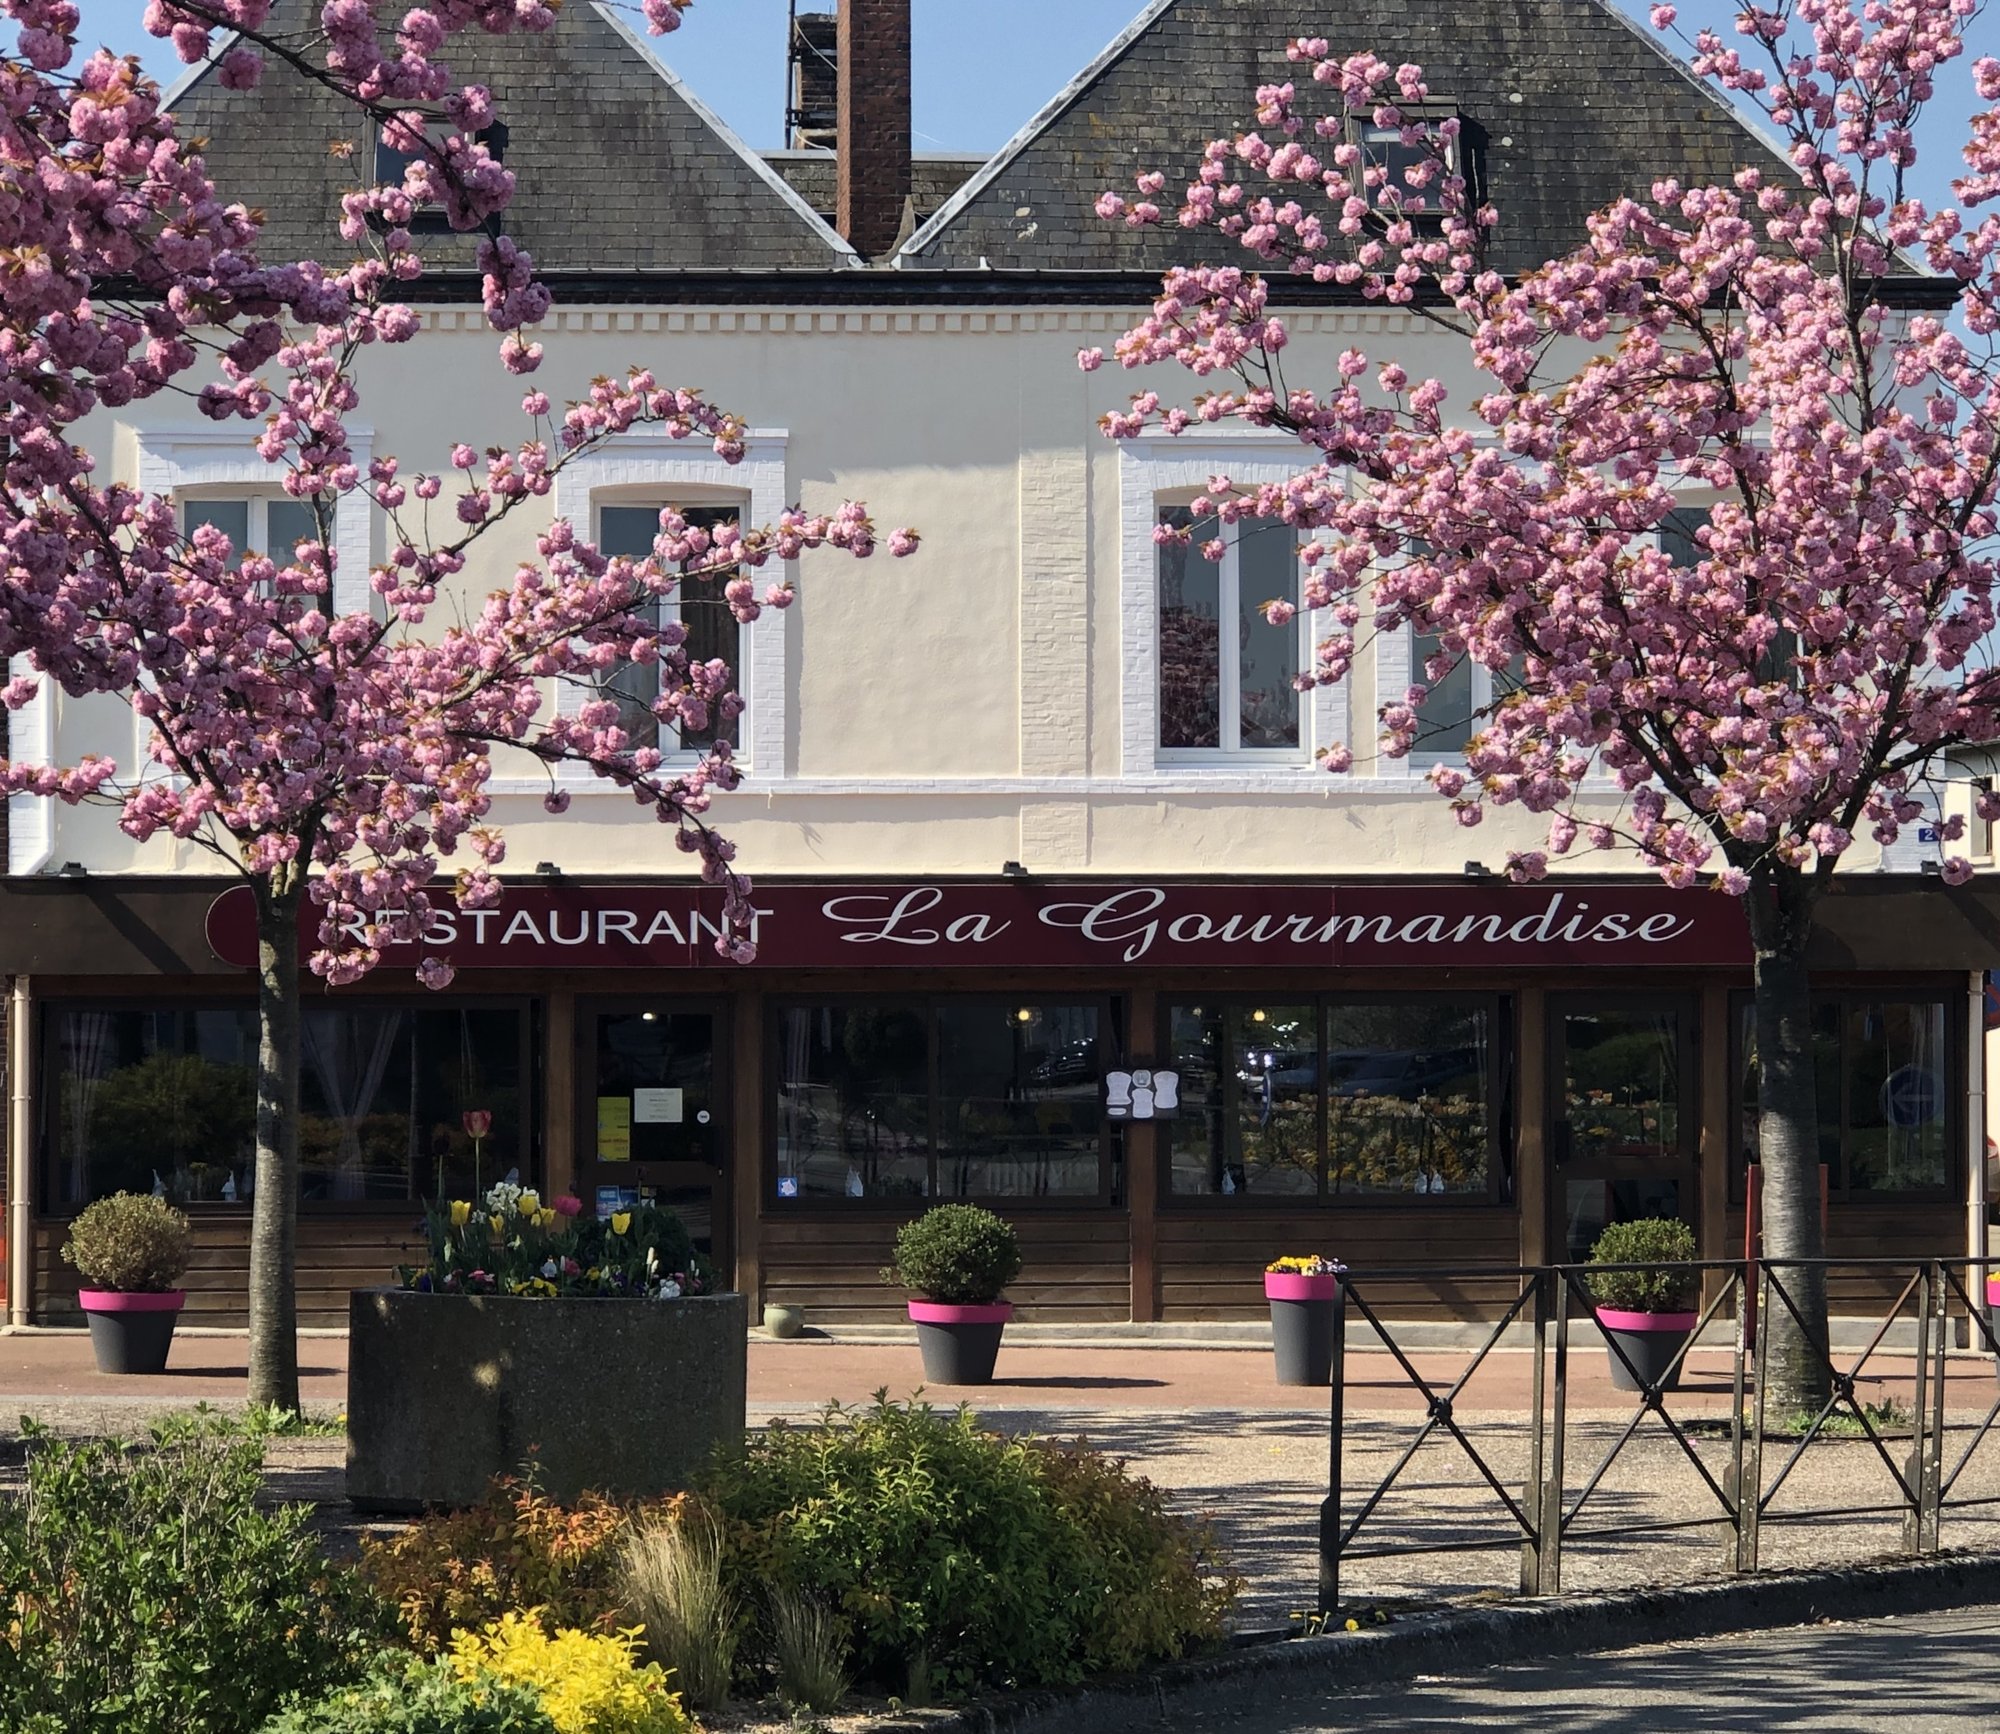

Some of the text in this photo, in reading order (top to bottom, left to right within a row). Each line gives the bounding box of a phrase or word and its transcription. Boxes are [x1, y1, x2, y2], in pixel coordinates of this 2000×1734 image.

[1923, 829, 1934, 841] 2
[822, 887, 1012, 945] La
[1038, 888, 1695, 962] Gourmandise
